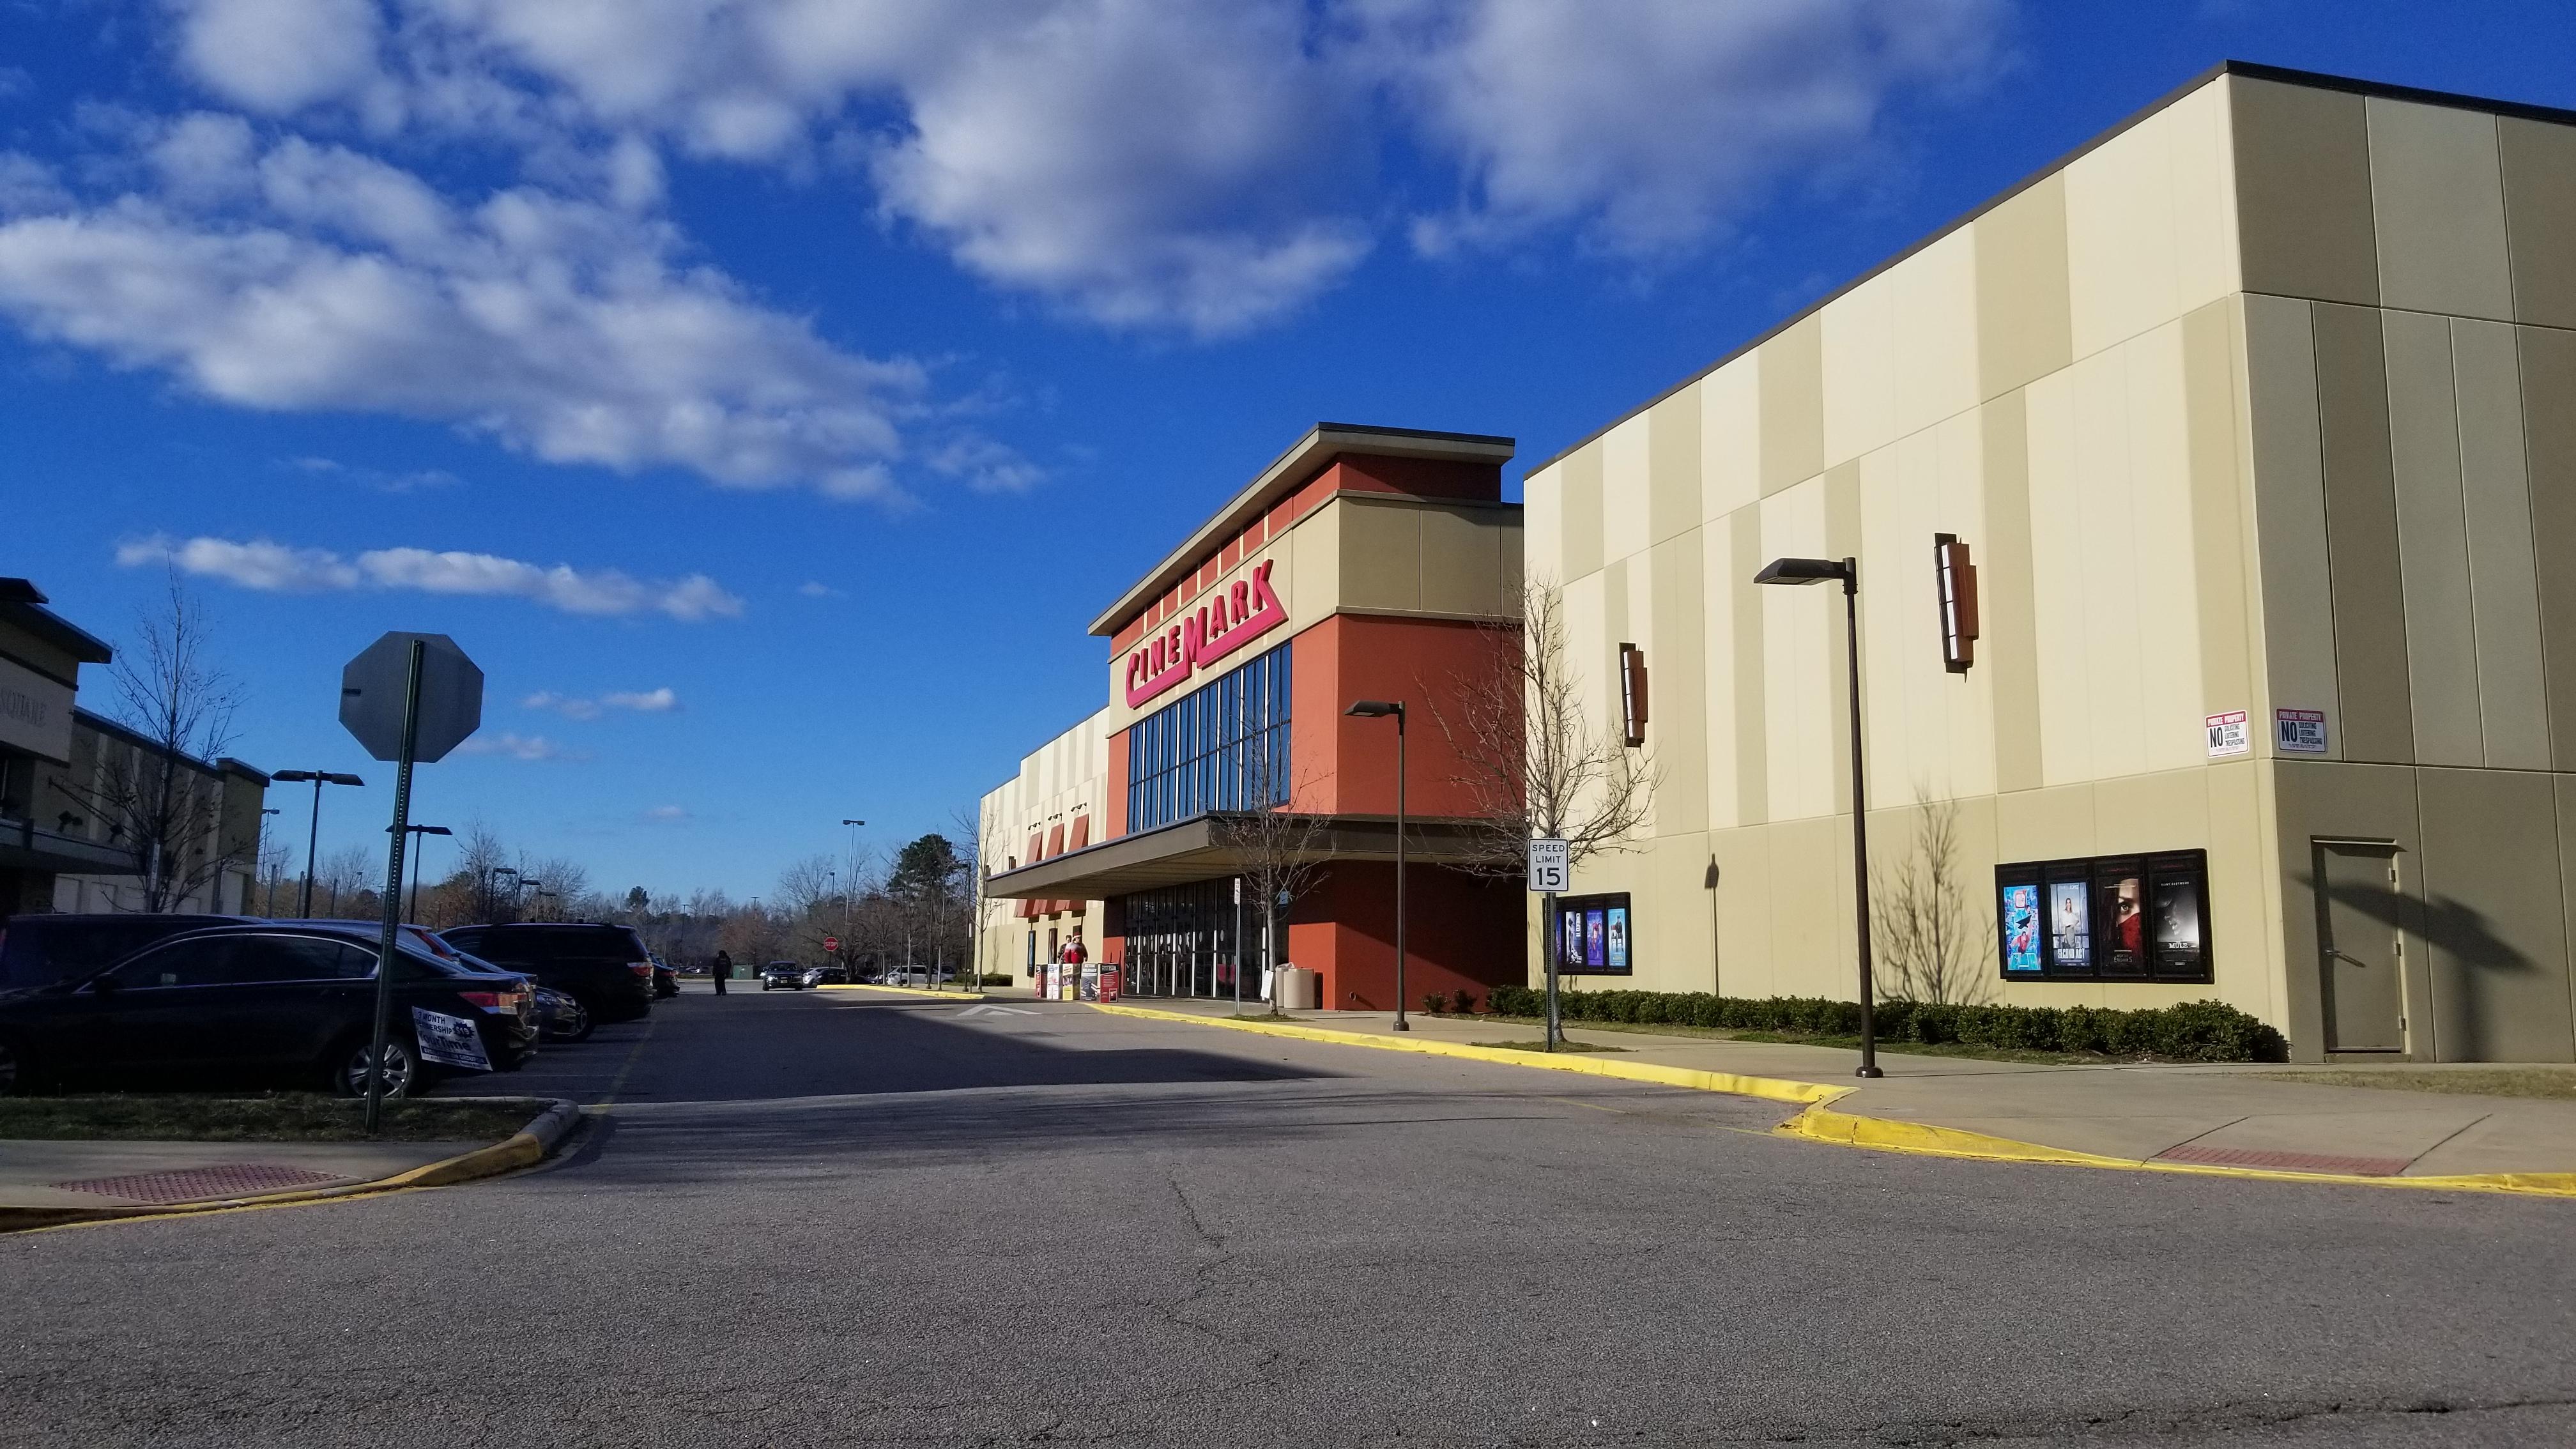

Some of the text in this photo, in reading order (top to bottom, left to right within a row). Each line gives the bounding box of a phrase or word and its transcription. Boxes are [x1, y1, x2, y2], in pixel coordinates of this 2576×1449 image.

[1125, 559, 1289, 709] CINEMARK
[2279, 711, 2321, 721] PRIVATE PROPERTY
[2209, 727, 2223, 747] NO
[2281, 721, 2297, 742] NO
[2225, 738, 2245, 746] TRESPASSING
[1537, 867, 1561, 886] 15
[2057, 948, 2085, 959] SECOND ACT
[423, 1013, 445, 1024] MONTH
